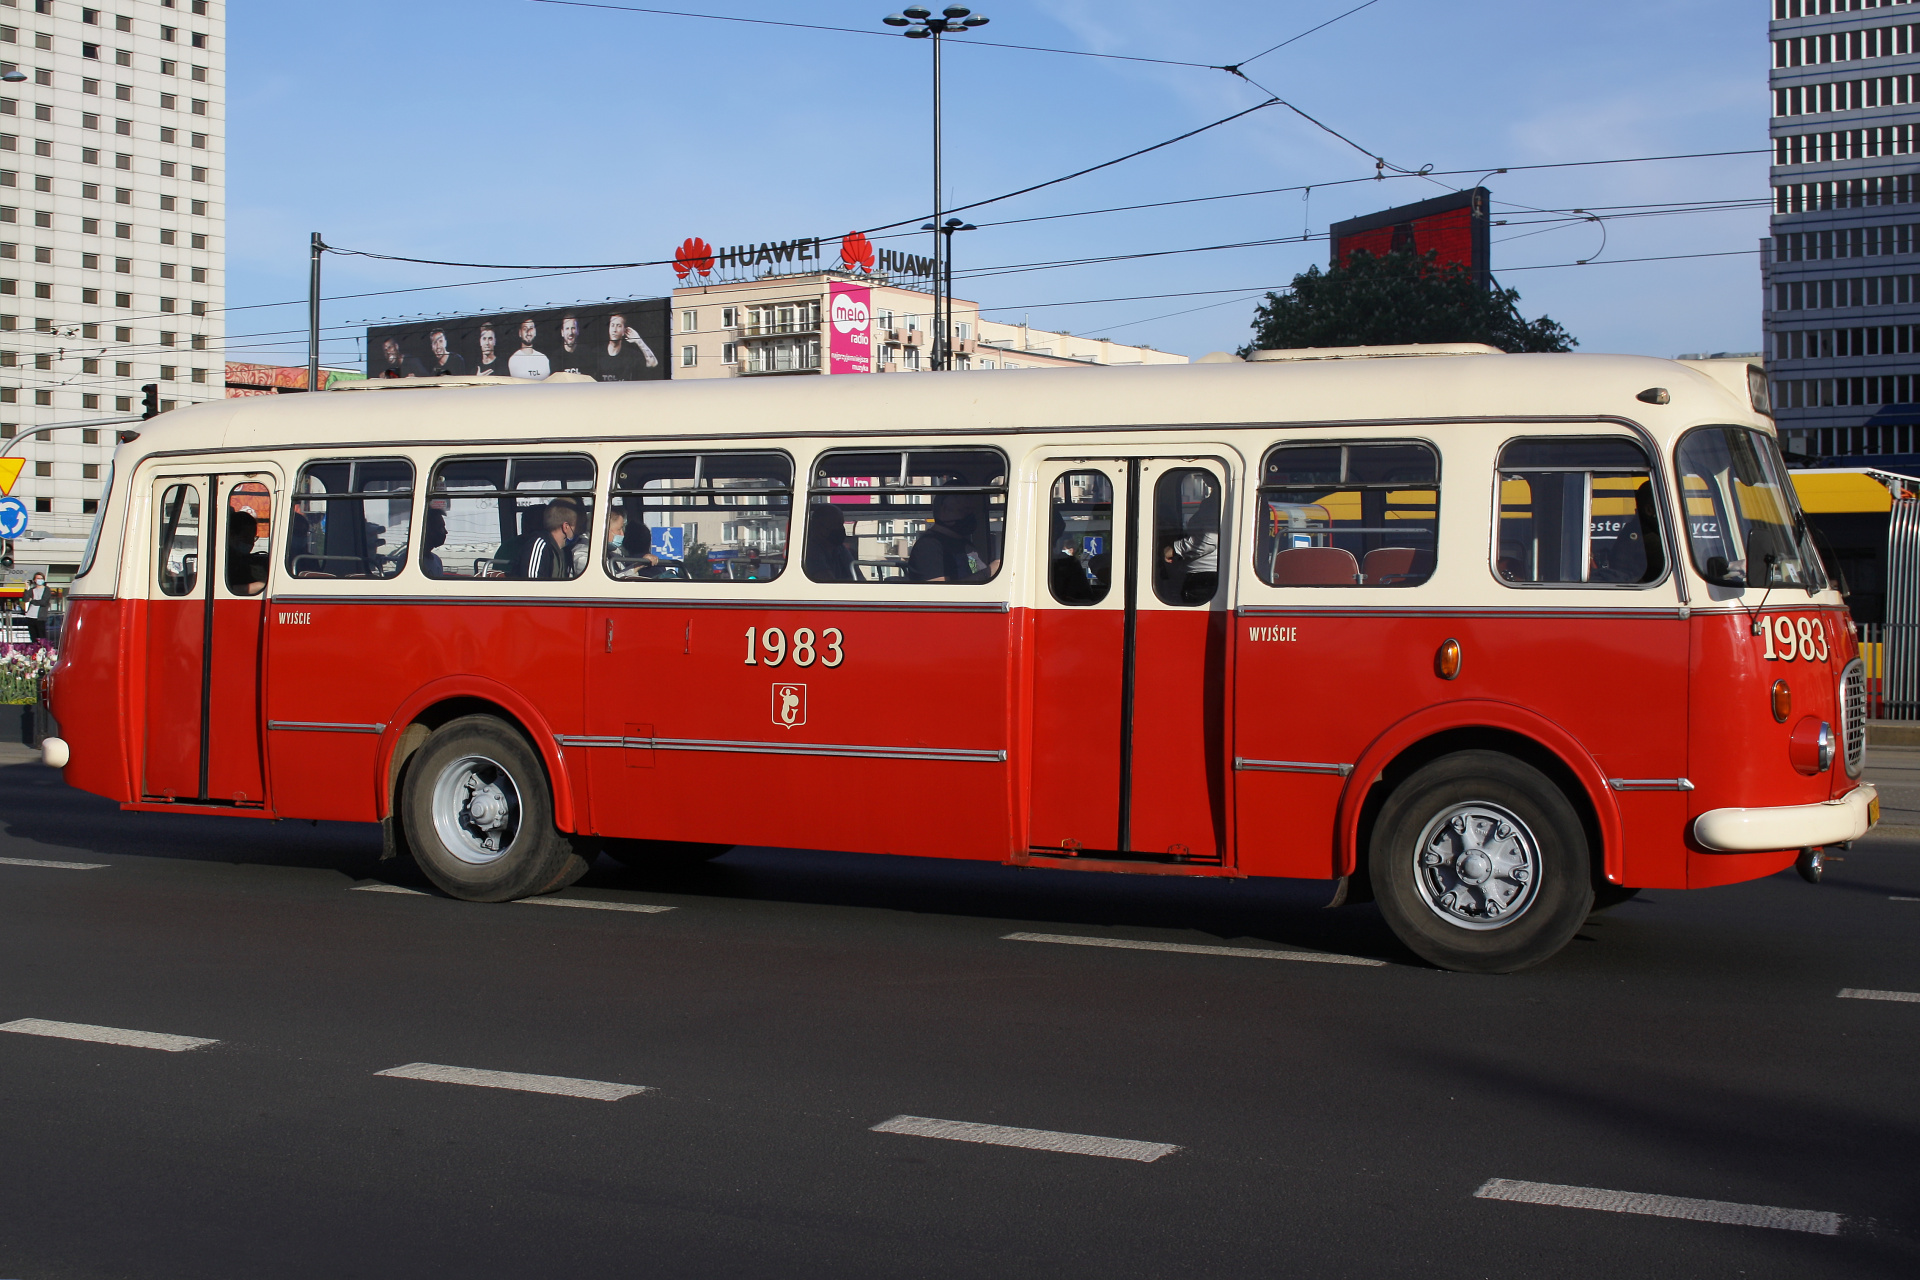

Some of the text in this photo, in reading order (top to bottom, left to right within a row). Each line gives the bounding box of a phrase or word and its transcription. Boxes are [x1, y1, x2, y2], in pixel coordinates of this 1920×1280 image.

[719, 237, 820, 269] HUAWEI
[836, 306, 865, 323] melo
[850, 333, 868, 345] radio
[852, 364, 869, 373] muzyka
[278, 610, 311, 625] WYJŚCIE
[1249, 624, 1297, 642] WYJŚCIE
[1760, 615, 1829, 662] 1983
[744, 626, 845, 668] 1983
